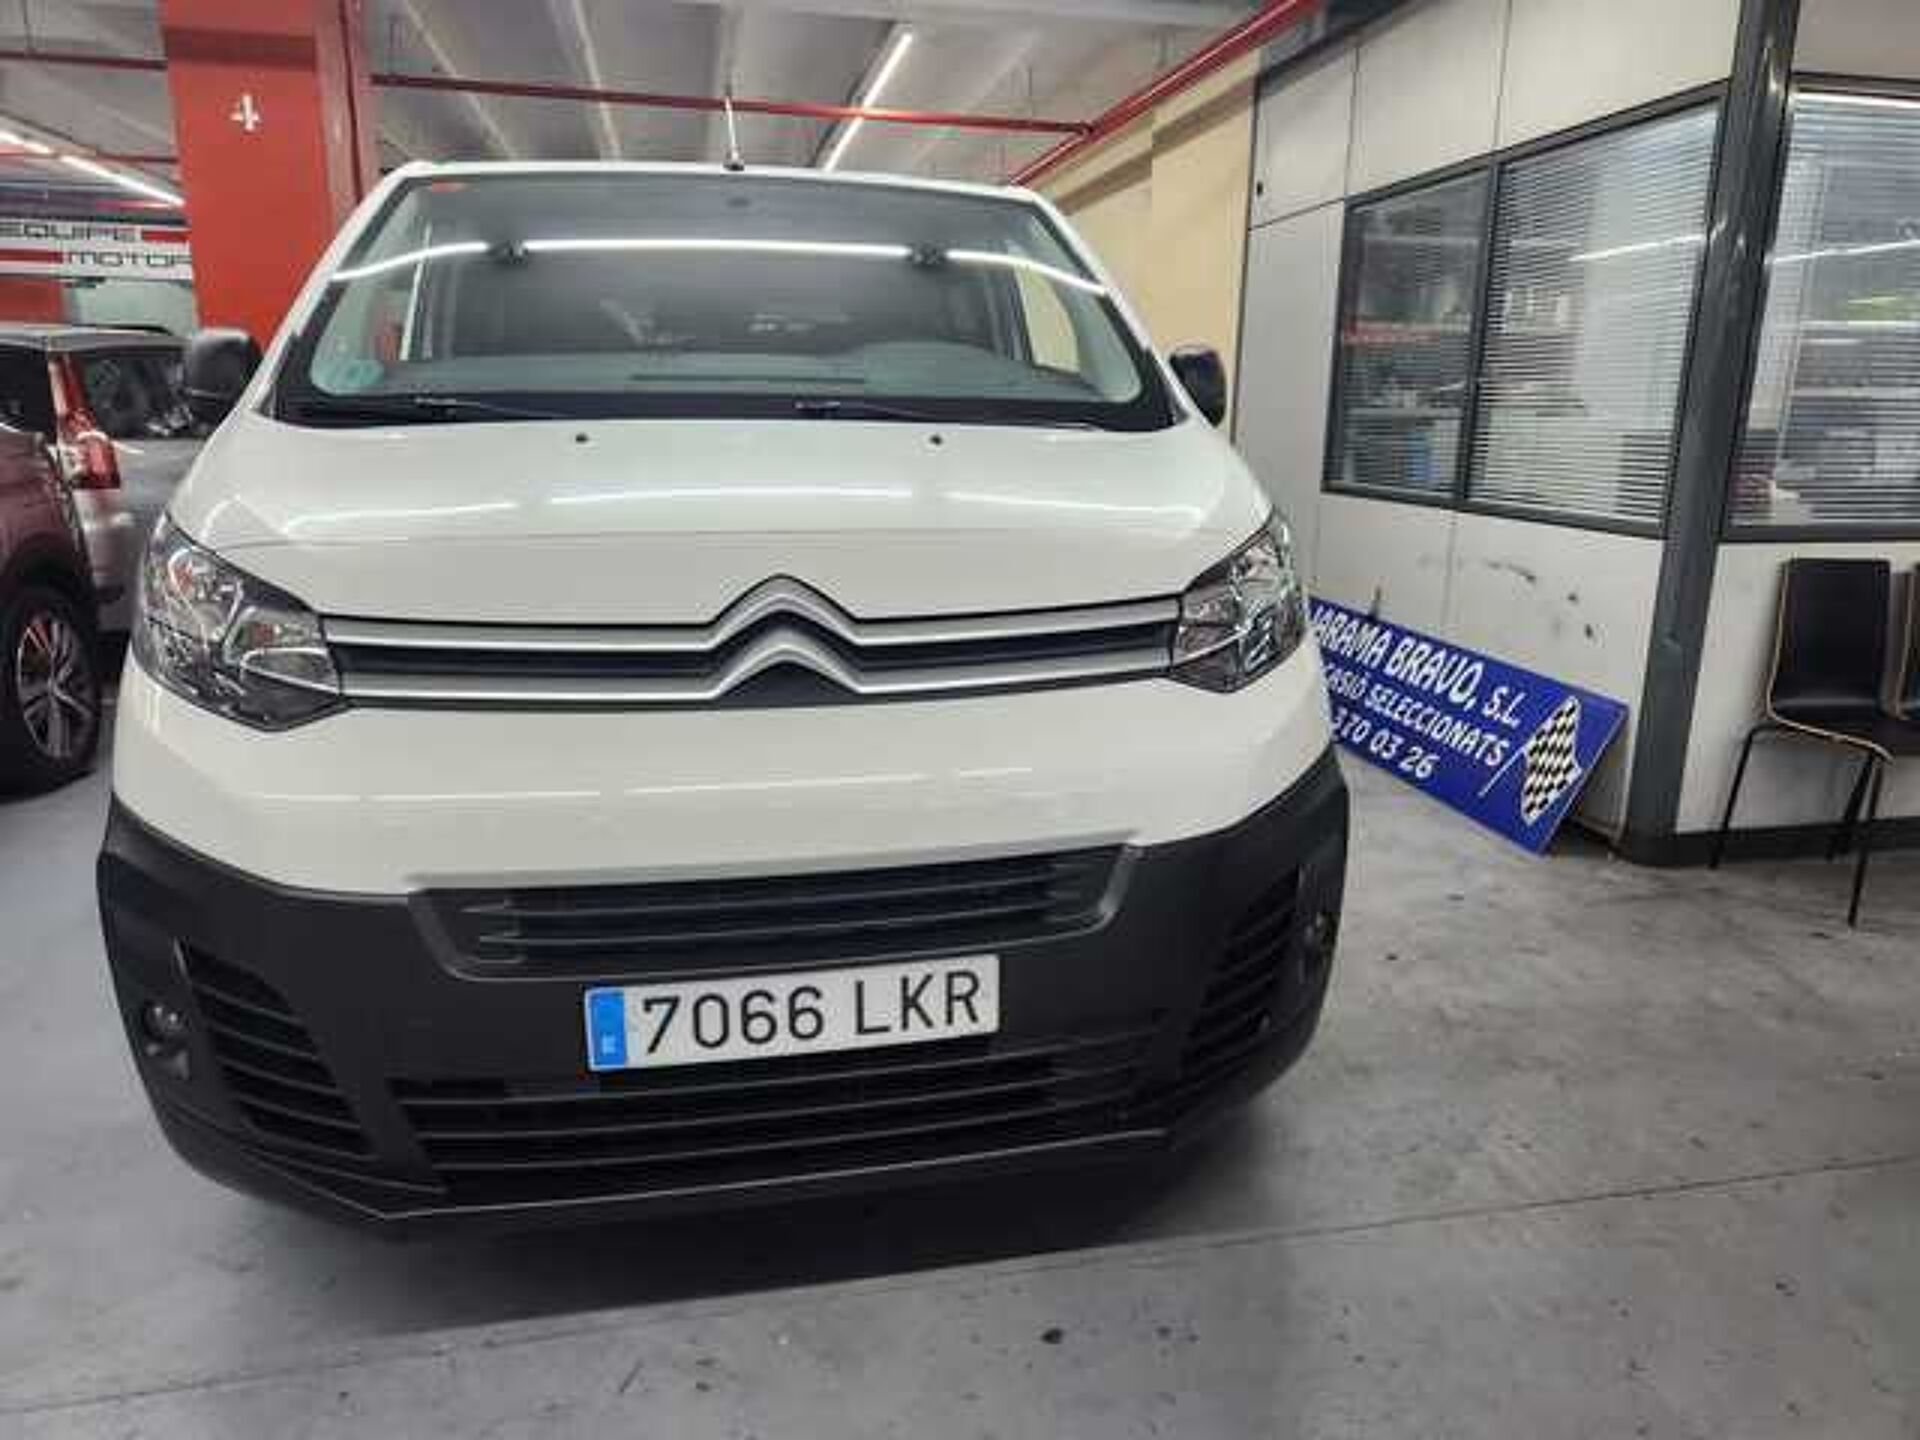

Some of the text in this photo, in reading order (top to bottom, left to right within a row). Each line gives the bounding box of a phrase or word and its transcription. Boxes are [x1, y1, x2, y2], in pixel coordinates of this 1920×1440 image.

[230, 94, 260, 132] 4
[1365, 683, 1510, 766] SELECCIONATS
[1370, 729, 1405, 760] 03
[1398, 746, 1440, 778] 26
[642, 969, 980, 1054] 7066 LKR
